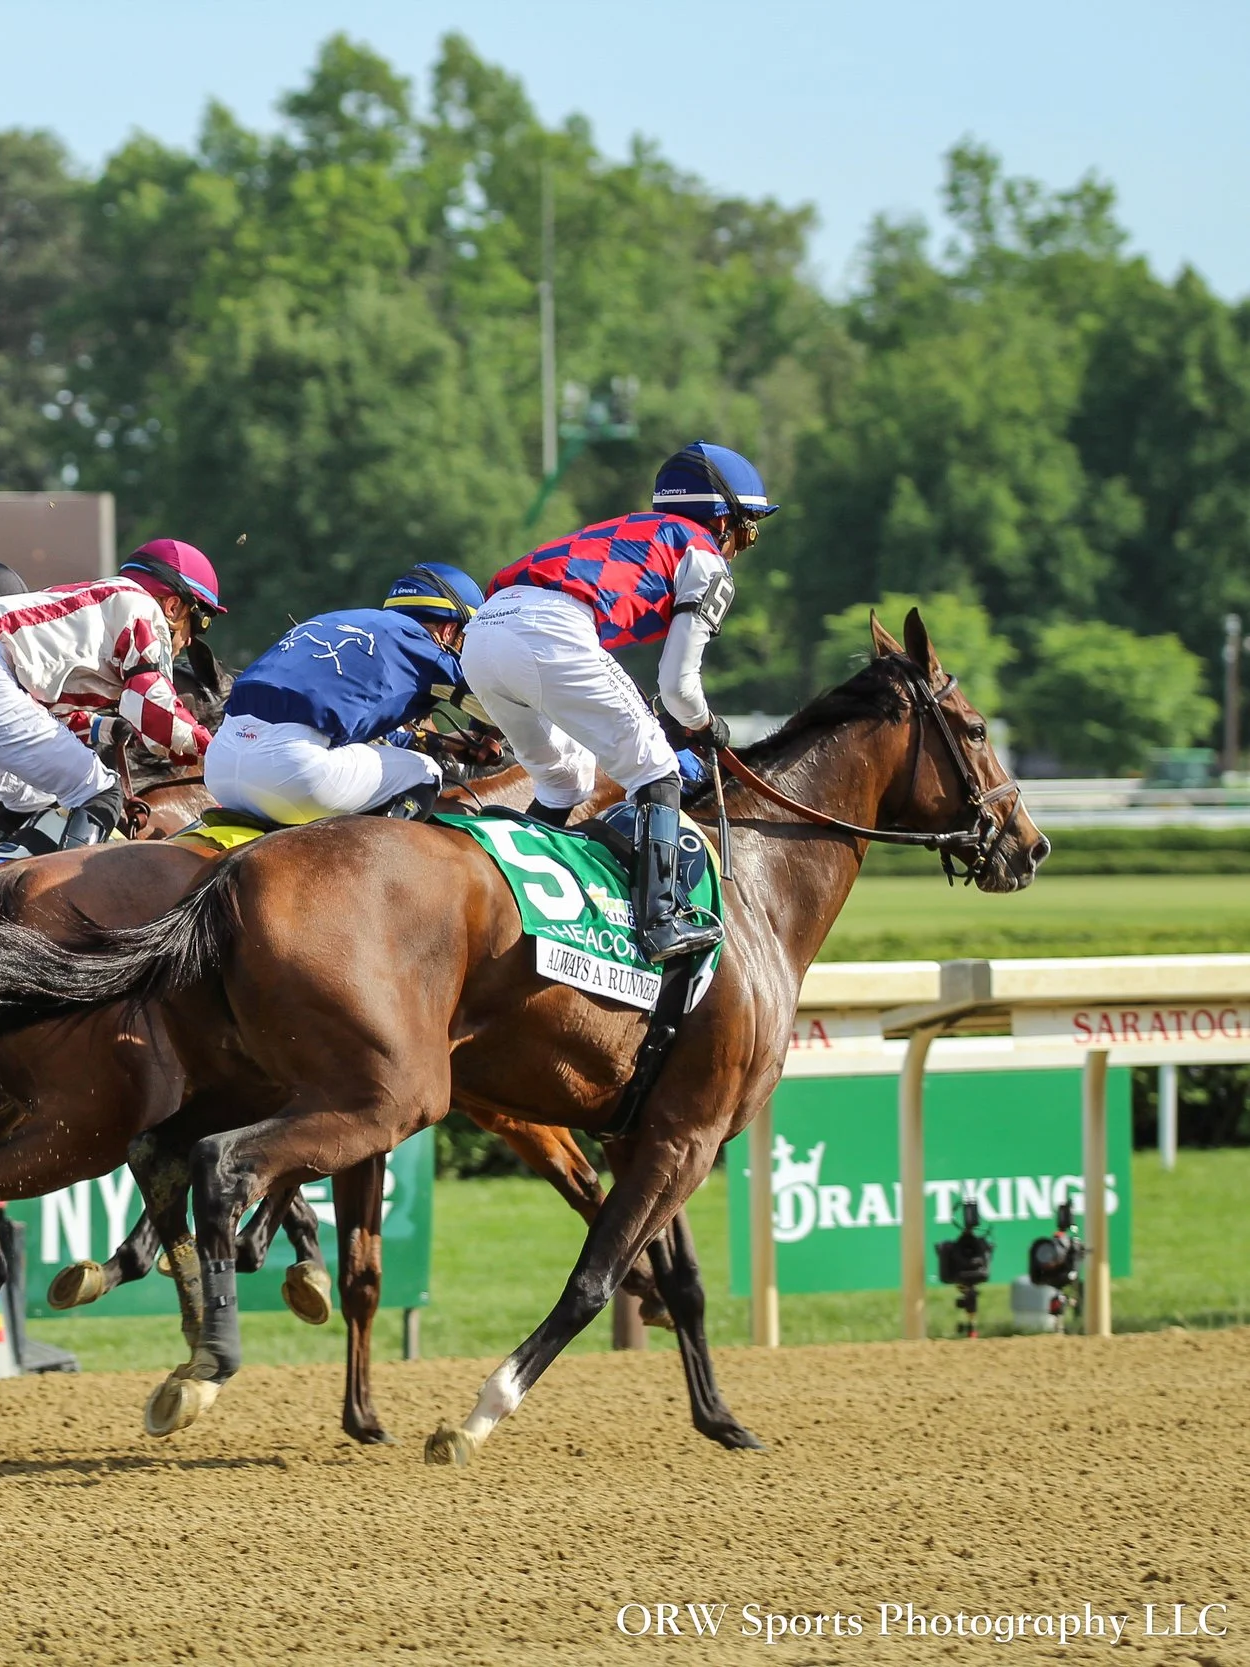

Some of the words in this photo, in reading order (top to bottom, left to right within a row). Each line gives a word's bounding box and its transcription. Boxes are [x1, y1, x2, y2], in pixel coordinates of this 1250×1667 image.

[707, 576, 732, 625] 5
[472, 820, 586, 921] 5
[536, 923, 585, 944] THE
[603, 910, 635, 927] KING
[546, 948, 591, 982] ALWAYS
[592, 964, 602, 986] A
[608, 966, 658, 1002] RUNNER
[1072, 1008, 1250, 1044] SARATOG
